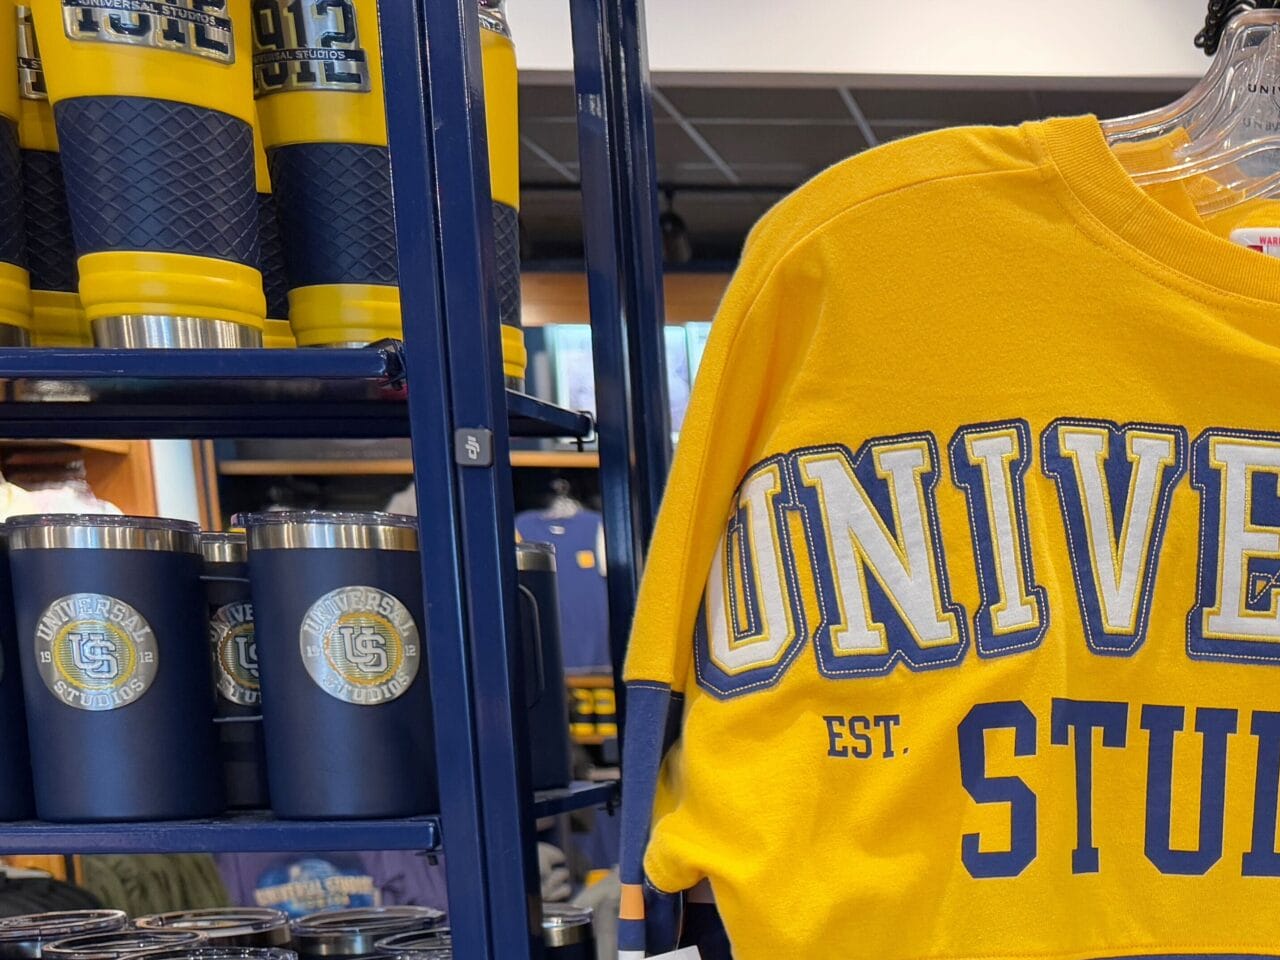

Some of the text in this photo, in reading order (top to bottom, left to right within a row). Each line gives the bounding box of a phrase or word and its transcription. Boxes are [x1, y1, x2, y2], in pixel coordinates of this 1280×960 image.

[161, 4, 217, 26] STUDIOS
[295, 50, 346, 60] STUDIOS
[36, 597, 152, 643] UNIVERSAL
[302, 589, 416, 638] UNIVERSAL
[39, 650, 154, 664] 19 12
[404, 644, 417, 658] 12
[53, 678, 146, 707] STUDIOS
[322, 673, 411, 703] STUDIOS
[822, 714, 910, 759] EST.
